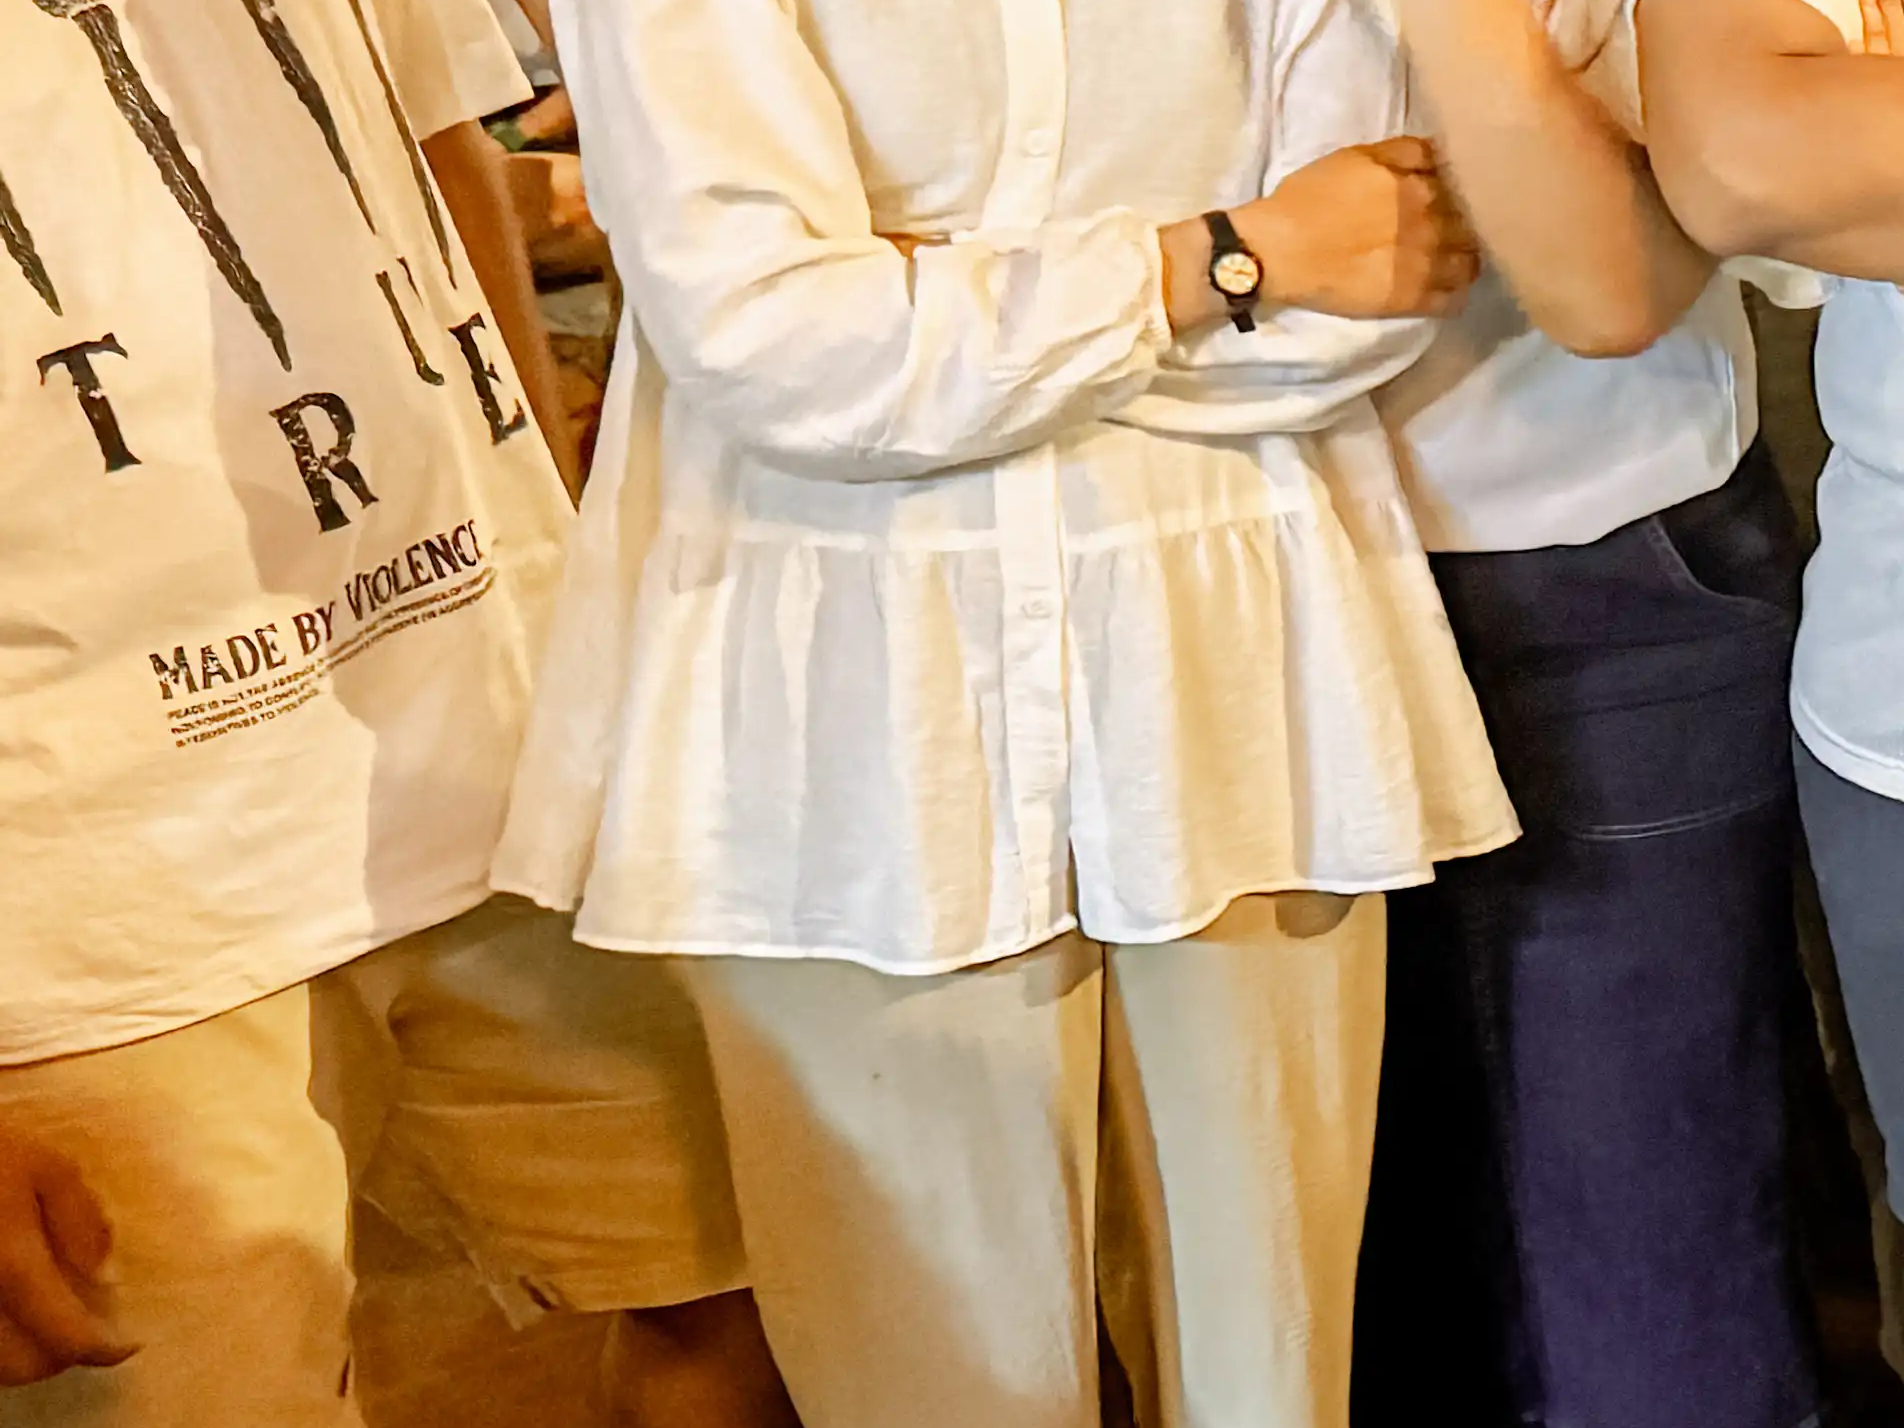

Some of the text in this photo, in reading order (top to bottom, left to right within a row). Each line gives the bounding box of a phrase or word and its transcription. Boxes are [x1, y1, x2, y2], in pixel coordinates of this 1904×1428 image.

[149, 623, 288, 700] MADE
[292, 601, 336, 655] BY
[344, 519, 484, 621] VIOLENC
